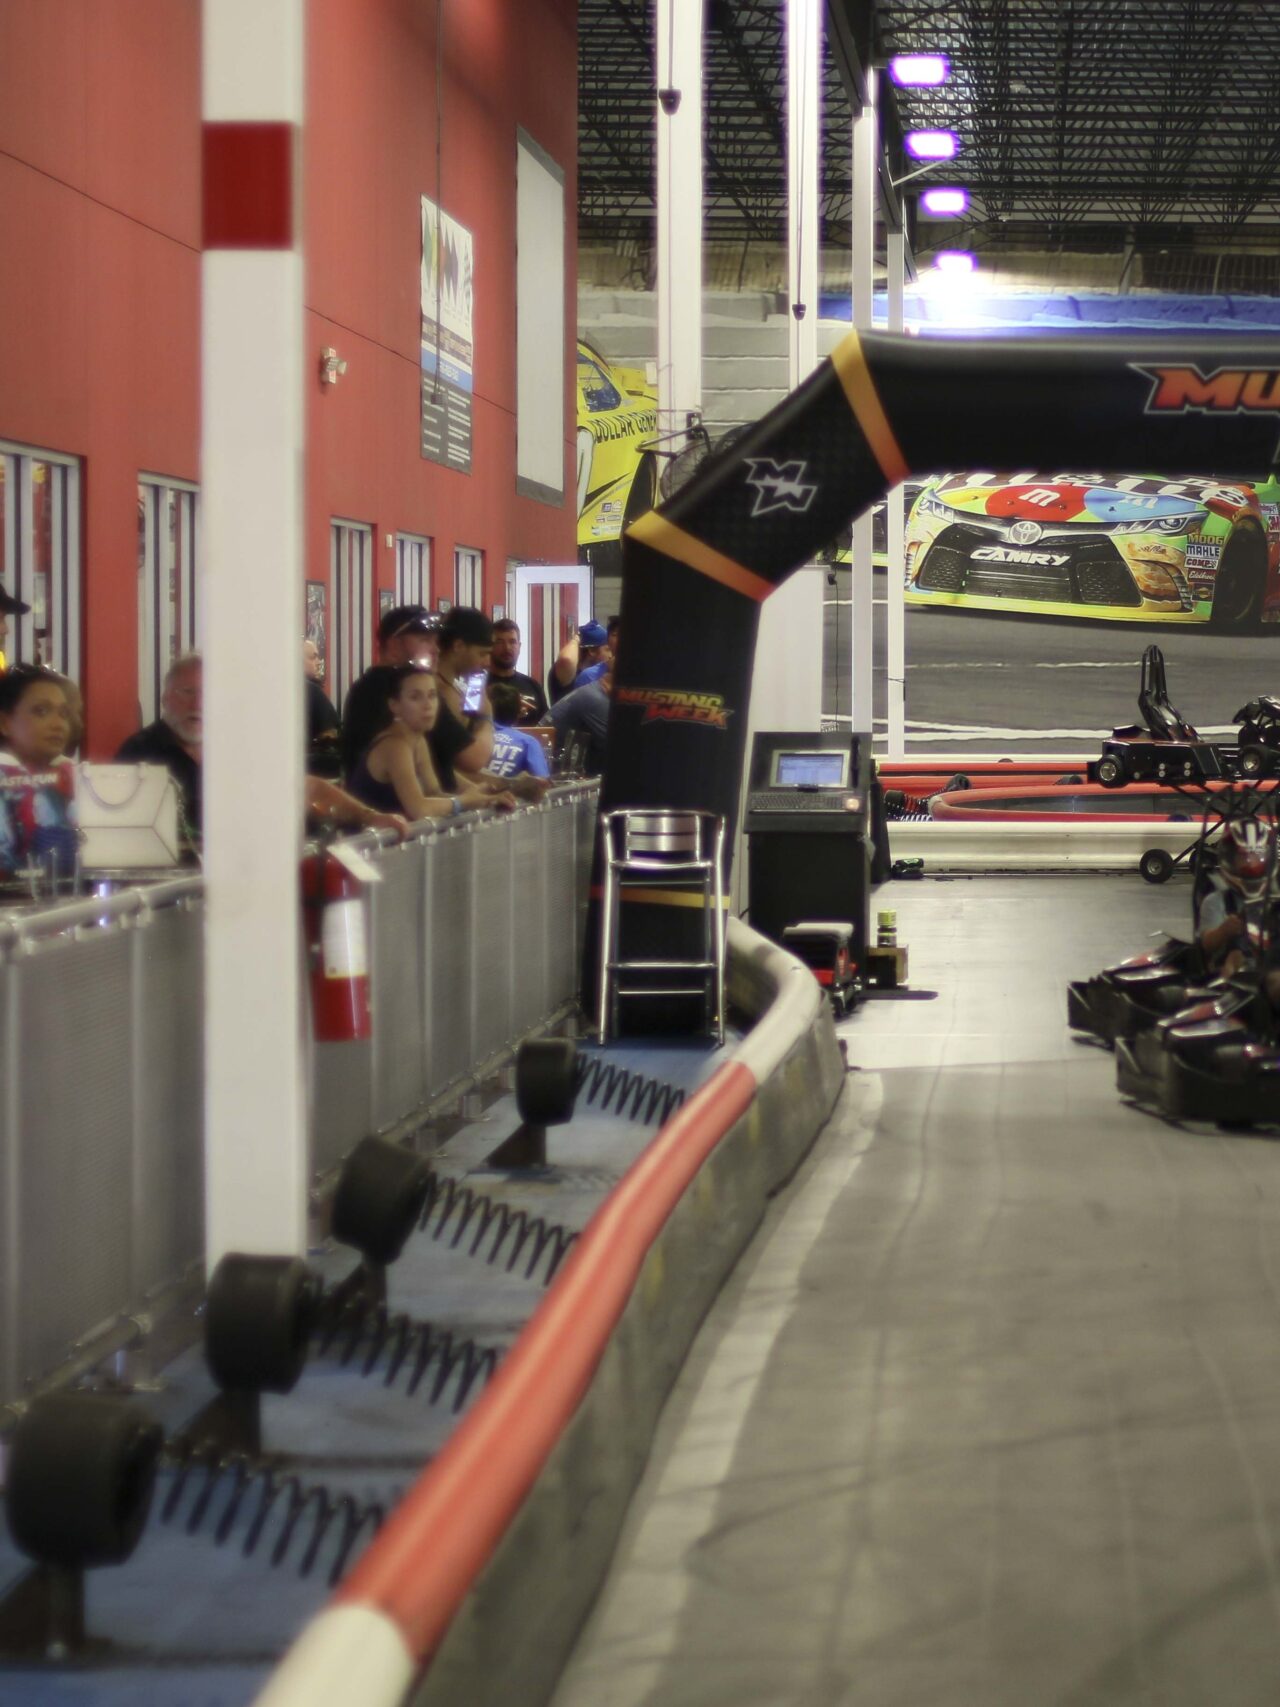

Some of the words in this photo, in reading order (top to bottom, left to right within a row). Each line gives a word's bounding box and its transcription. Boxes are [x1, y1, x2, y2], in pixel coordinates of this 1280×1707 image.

[1188, 533, 1224, 545] MOOG
[969, 548, 1071, 566] CAMRY
[1186, 545, 1220, 557] MAHLE
[616, 687, 722, 708] MUSTANG
[646, 703, 729, 728] WEEK
